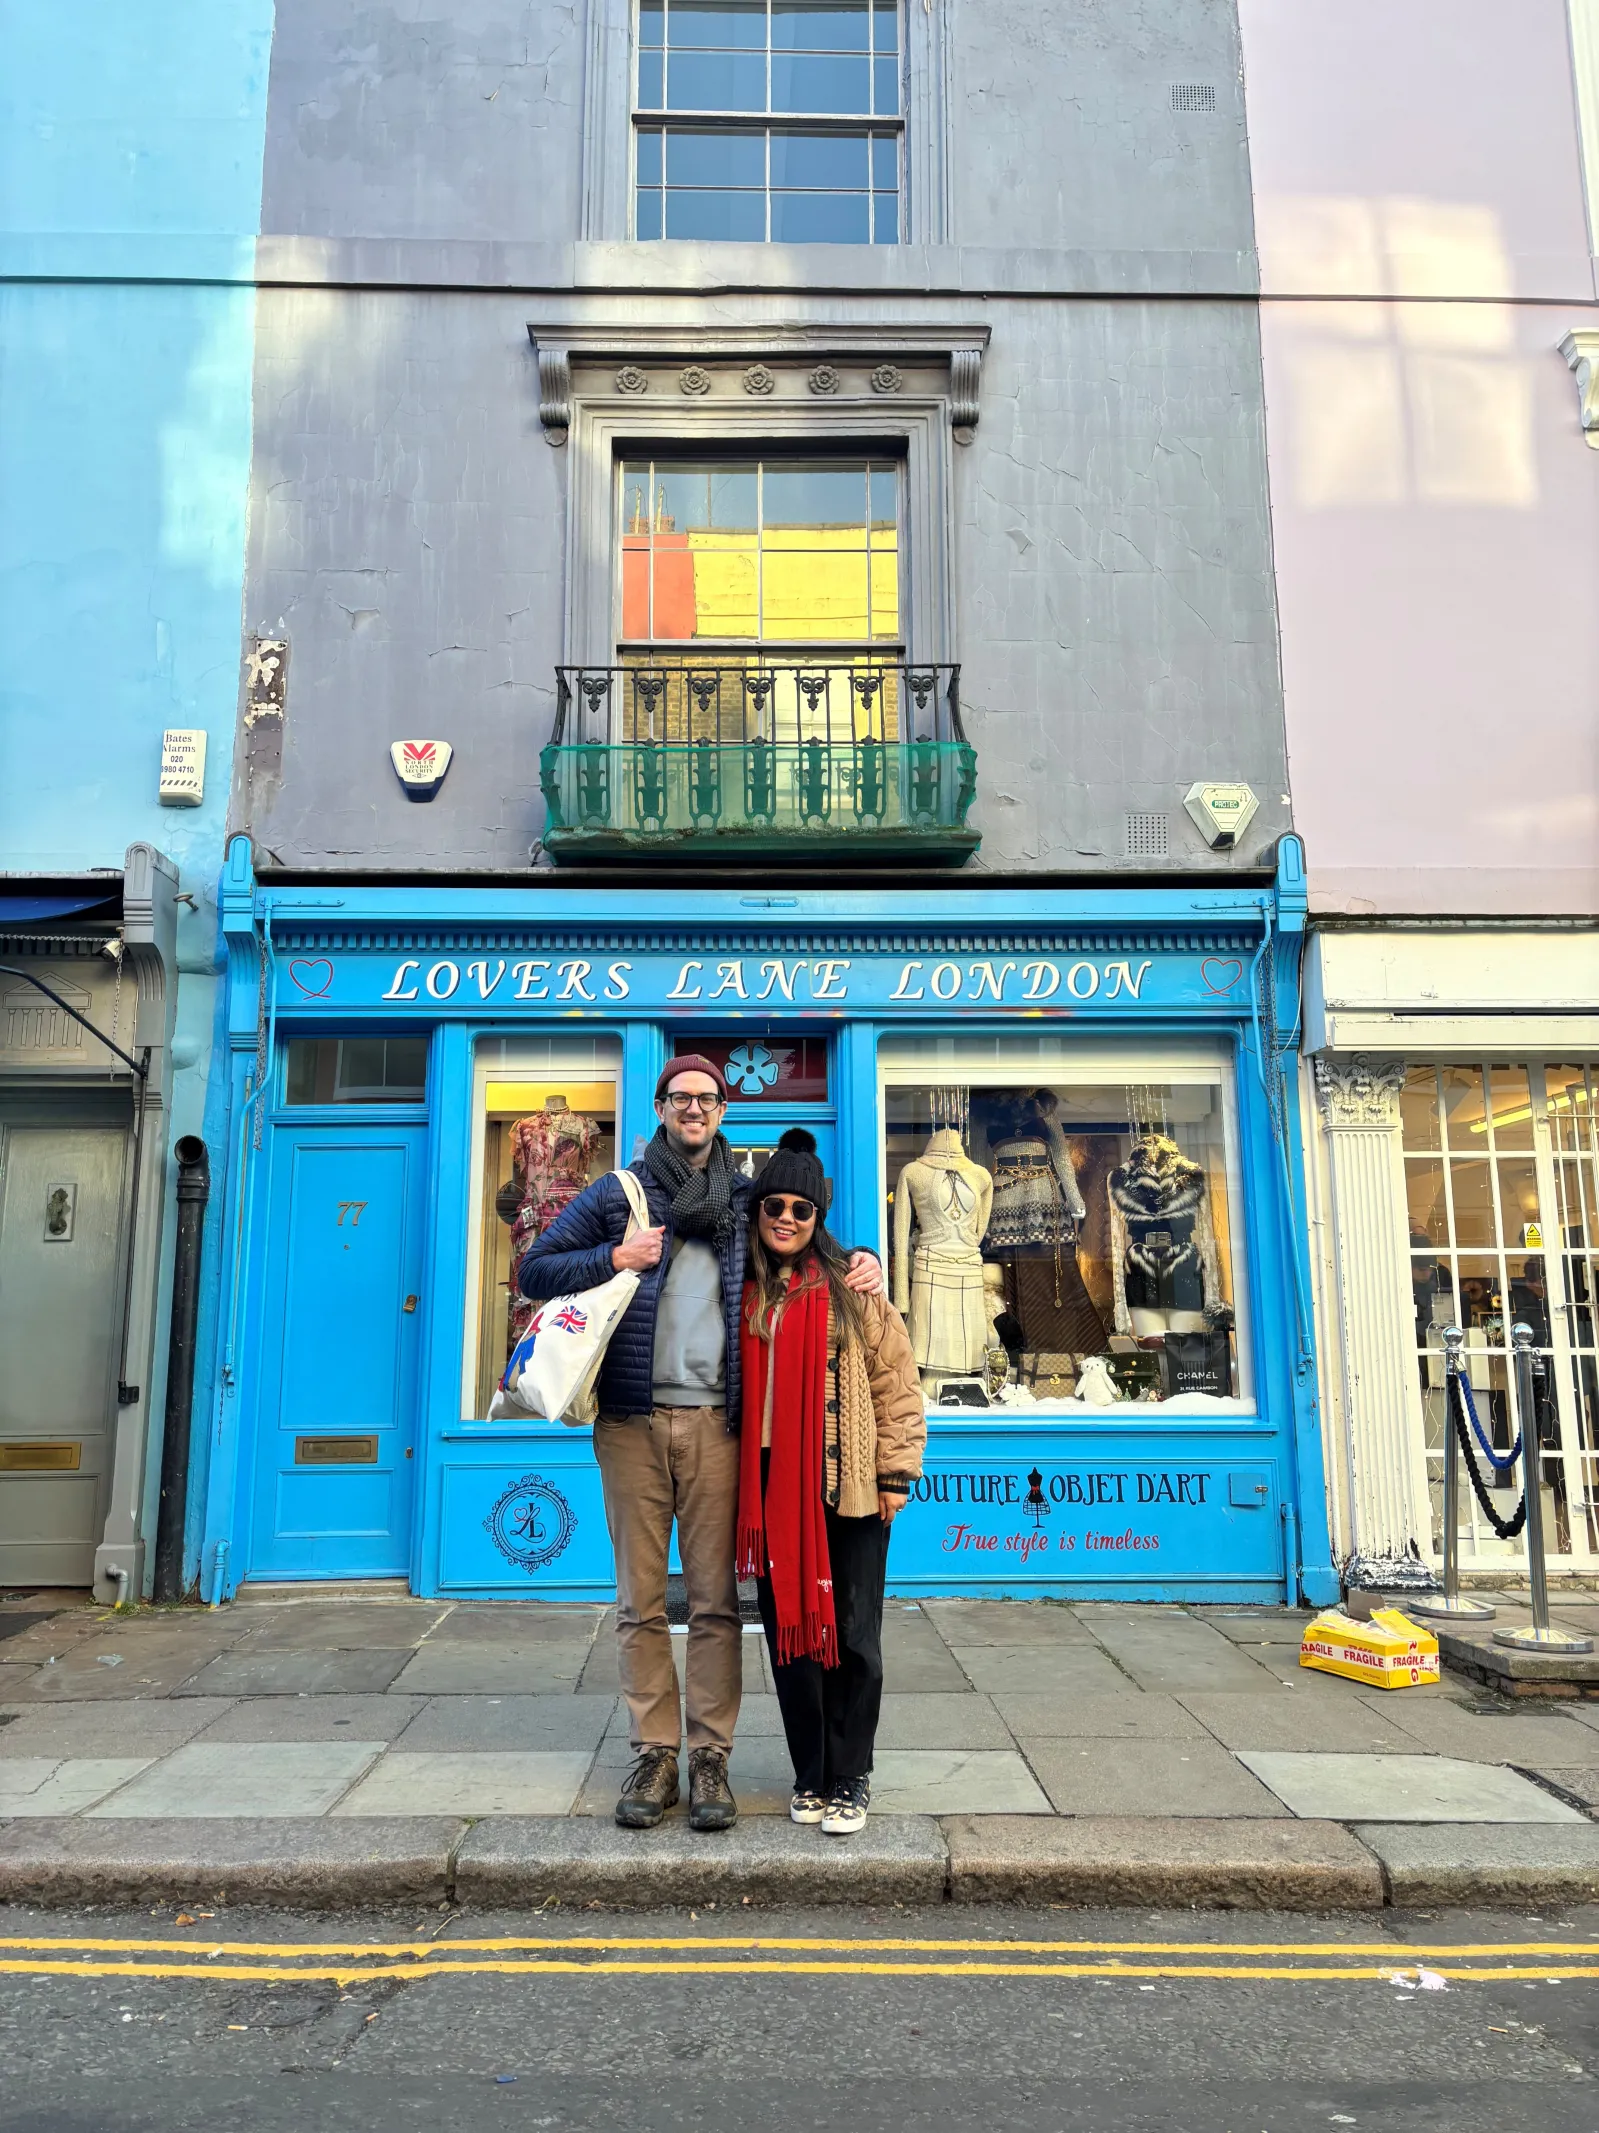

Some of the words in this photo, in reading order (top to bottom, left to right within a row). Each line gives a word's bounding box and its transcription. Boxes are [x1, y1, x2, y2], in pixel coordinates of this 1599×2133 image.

[165, 734, 192, 743] Bates
[170, 755, 184, 763] 020
[178, 766, 195, 774] 4710
[381, 958, 634, 1002] LOVERS
[665, 958, 852, 1002] LANE
[889, 959, 1154, 1002] LONDON
[337, 1201, 369, 1226] 77
[1176, 1371, 1219, 1380] CHANEL
[1049, 1472, 1129, 1507] OBJET
[1136, 1472, 1211, 1506] D'ART
[942, 1523, 999, 1552] True
[1003, 1530, 1049, 1564] style
[1058, 1529, 1076, 1551] is
[1084, 1527, 1160, 1551] timeless
[1343, 1649, 1385, 1668] FRAGILE
[1392, 1655, 1425, 1667] FRAGILE
